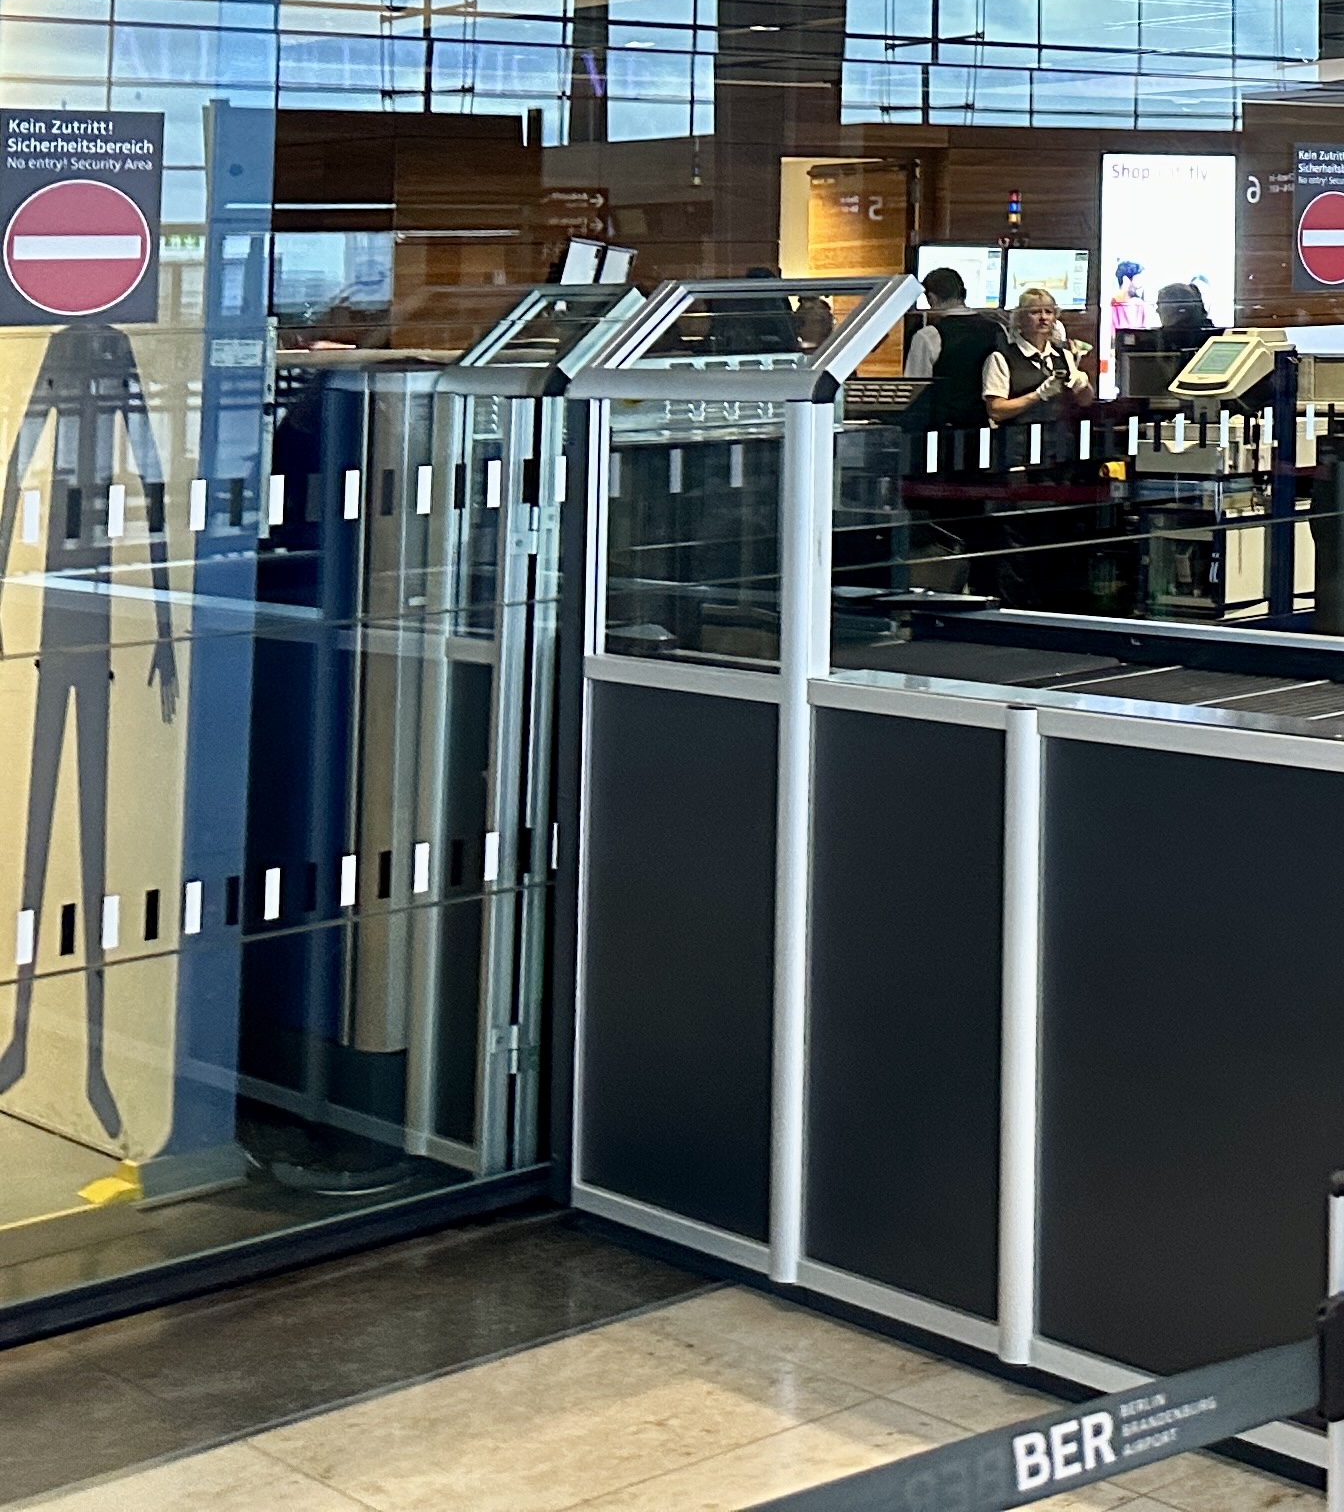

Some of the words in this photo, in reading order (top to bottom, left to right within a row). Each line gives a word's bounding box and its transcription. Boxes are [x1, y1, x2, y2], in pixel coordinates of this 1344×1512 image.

[8, 118, 46, 134] Kein
[51, 120, 113, 135] Zutritt!
[7, 137, 154, 155] Sicherheitsbereich
[1298, 149, 1317, 160] Kein
[7, 156, 26, 169] No
[28, 157, 68, 173] entry!
[70, 158, 123, 173] Security
[124, 159, 153, 171] Area
[1111, 162, 1150, 181] Shop
[1119, 1393, 1167, 1416] BERLIN
[1121, 1395, 1217, 1437] BRANDENBURG
[1012, 1411, 1116, 1491] BER
[1122, 1428, 1178, 1456] AIRPORT
